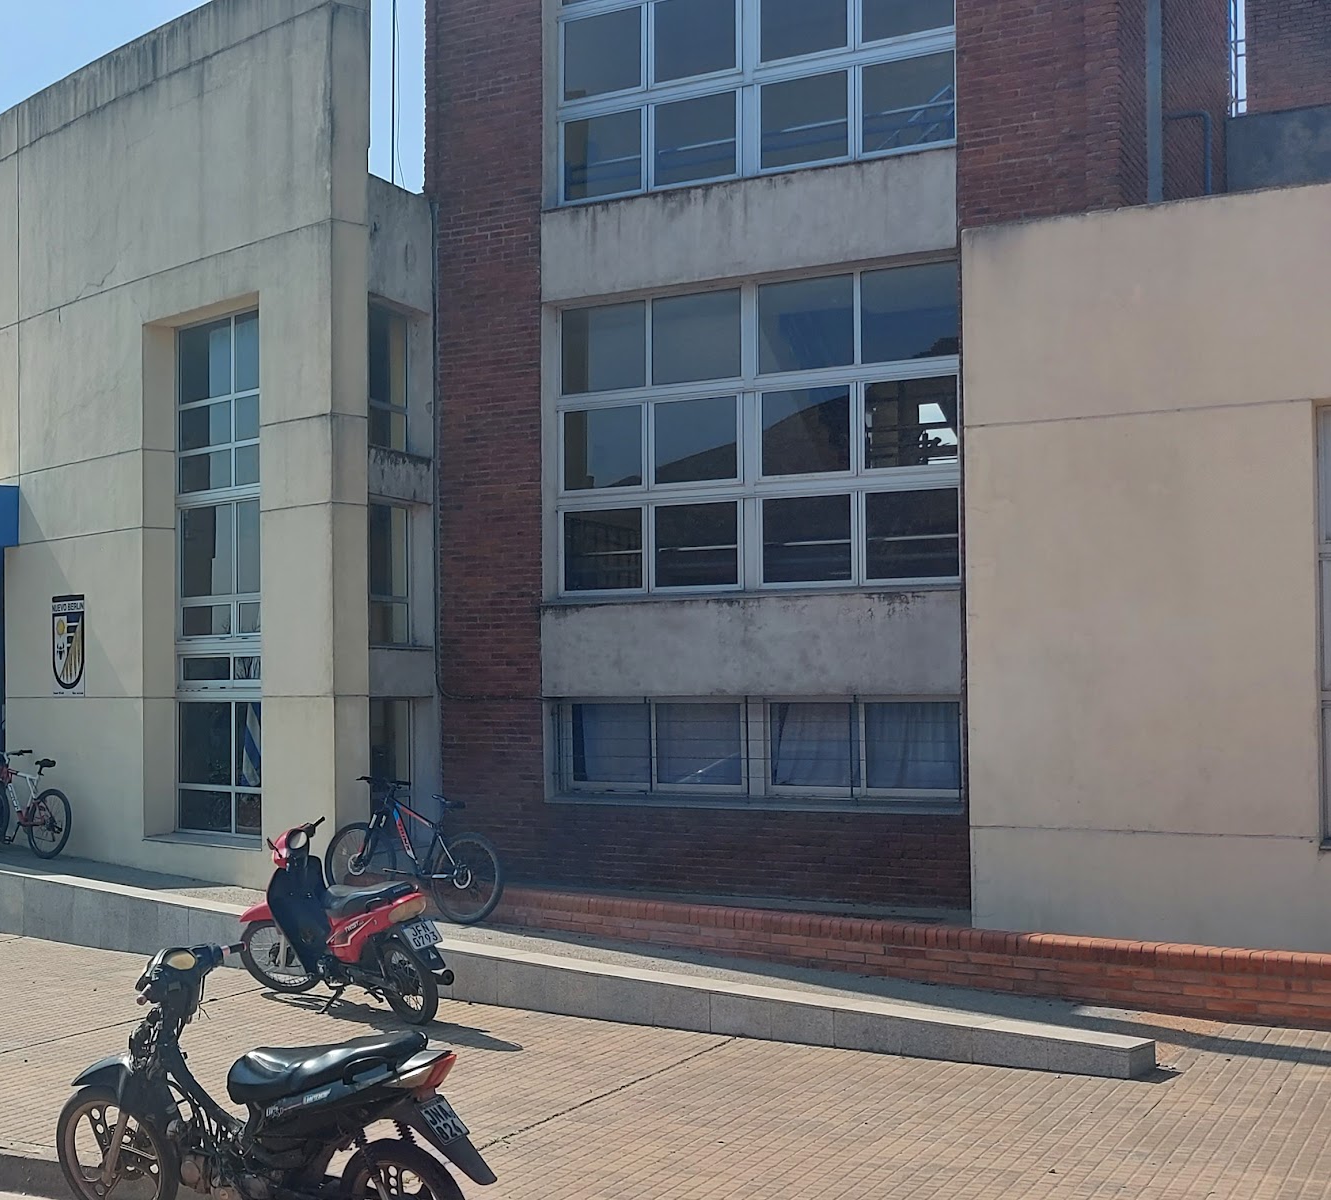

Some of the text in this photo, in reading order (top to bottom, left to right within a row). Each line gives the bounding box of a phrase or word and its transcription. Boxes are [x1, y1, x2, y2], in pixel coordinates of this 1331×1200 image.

[52, 602, 84, 612] NUEVO BERLIN
[411, 921, 430, 937] JFN
[412, 931, 438, 947] 0793
